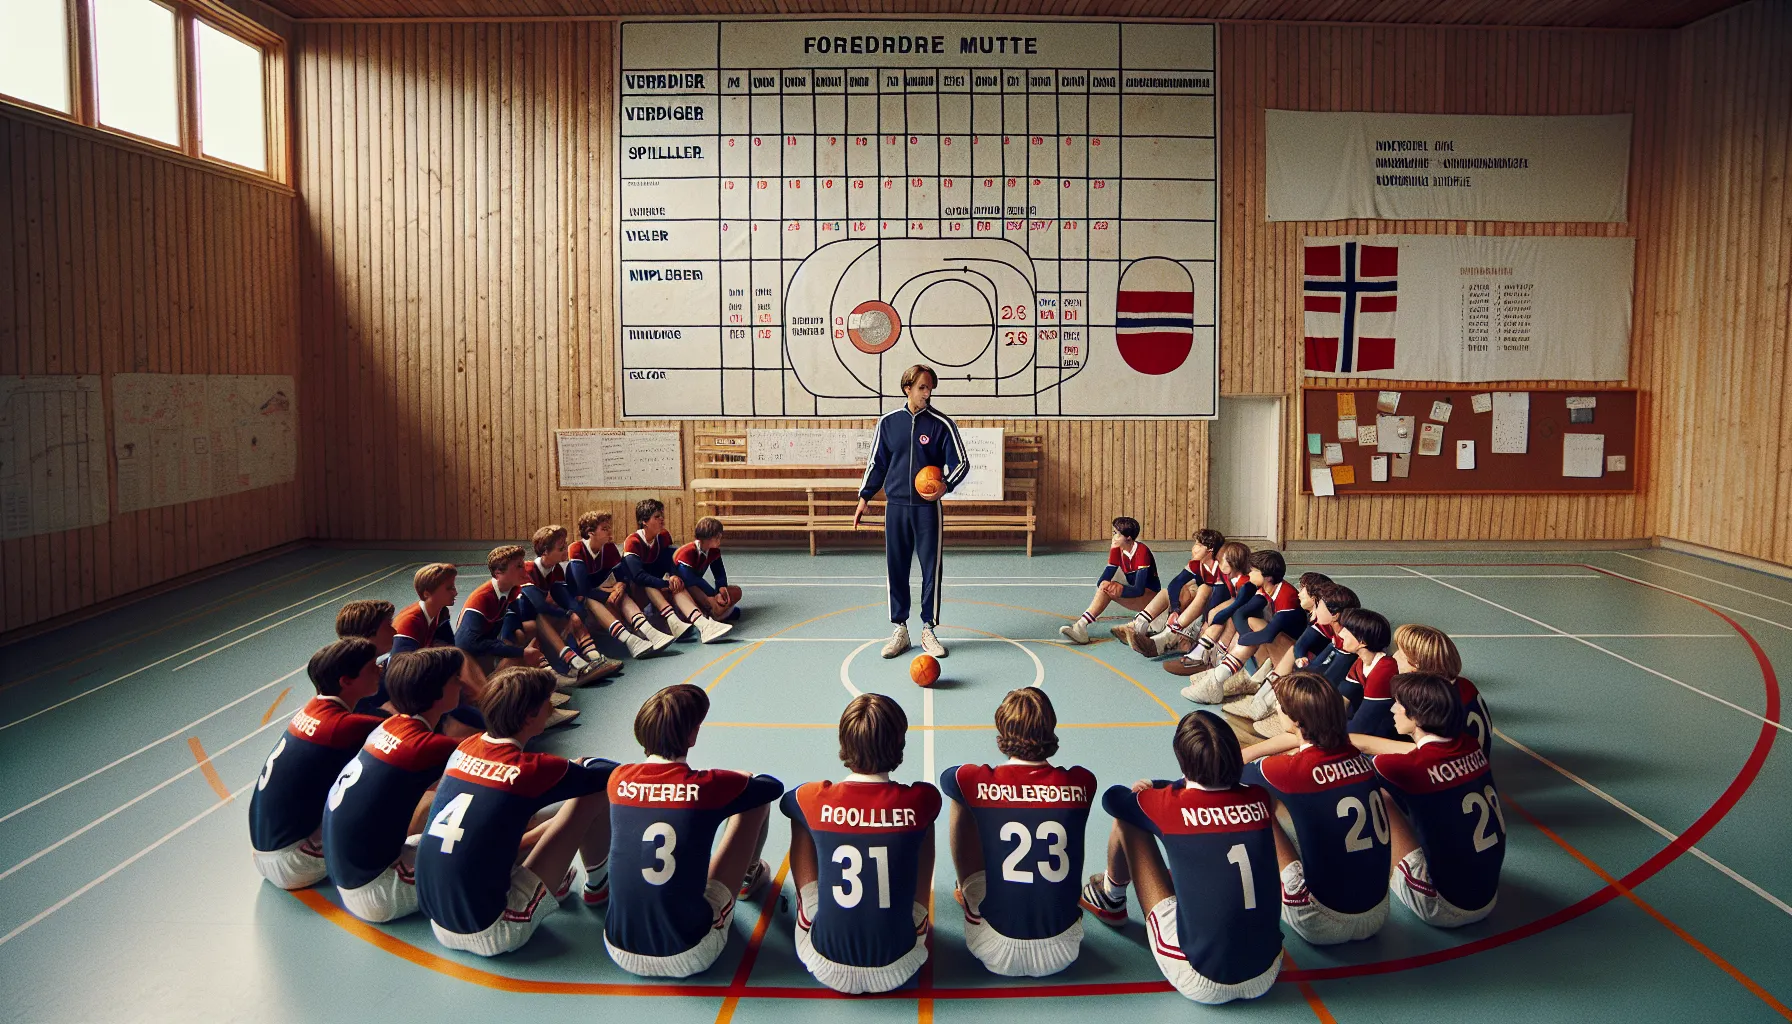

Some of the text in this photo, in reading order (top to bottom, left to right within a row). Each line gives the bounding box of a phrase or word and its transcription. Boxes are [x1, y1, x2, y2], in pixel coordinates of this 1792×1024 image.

[960, 36, 1038, 54] MUTTE
[428, 792, 474, 854] 4
[641, 821, 677, 886] 3
[999, 820, 1070, 884] 23
[1336, 790, 1390, 853] 20
[831, 844, 890, 909] 31
[1226, 843, 1257, 910] 1
